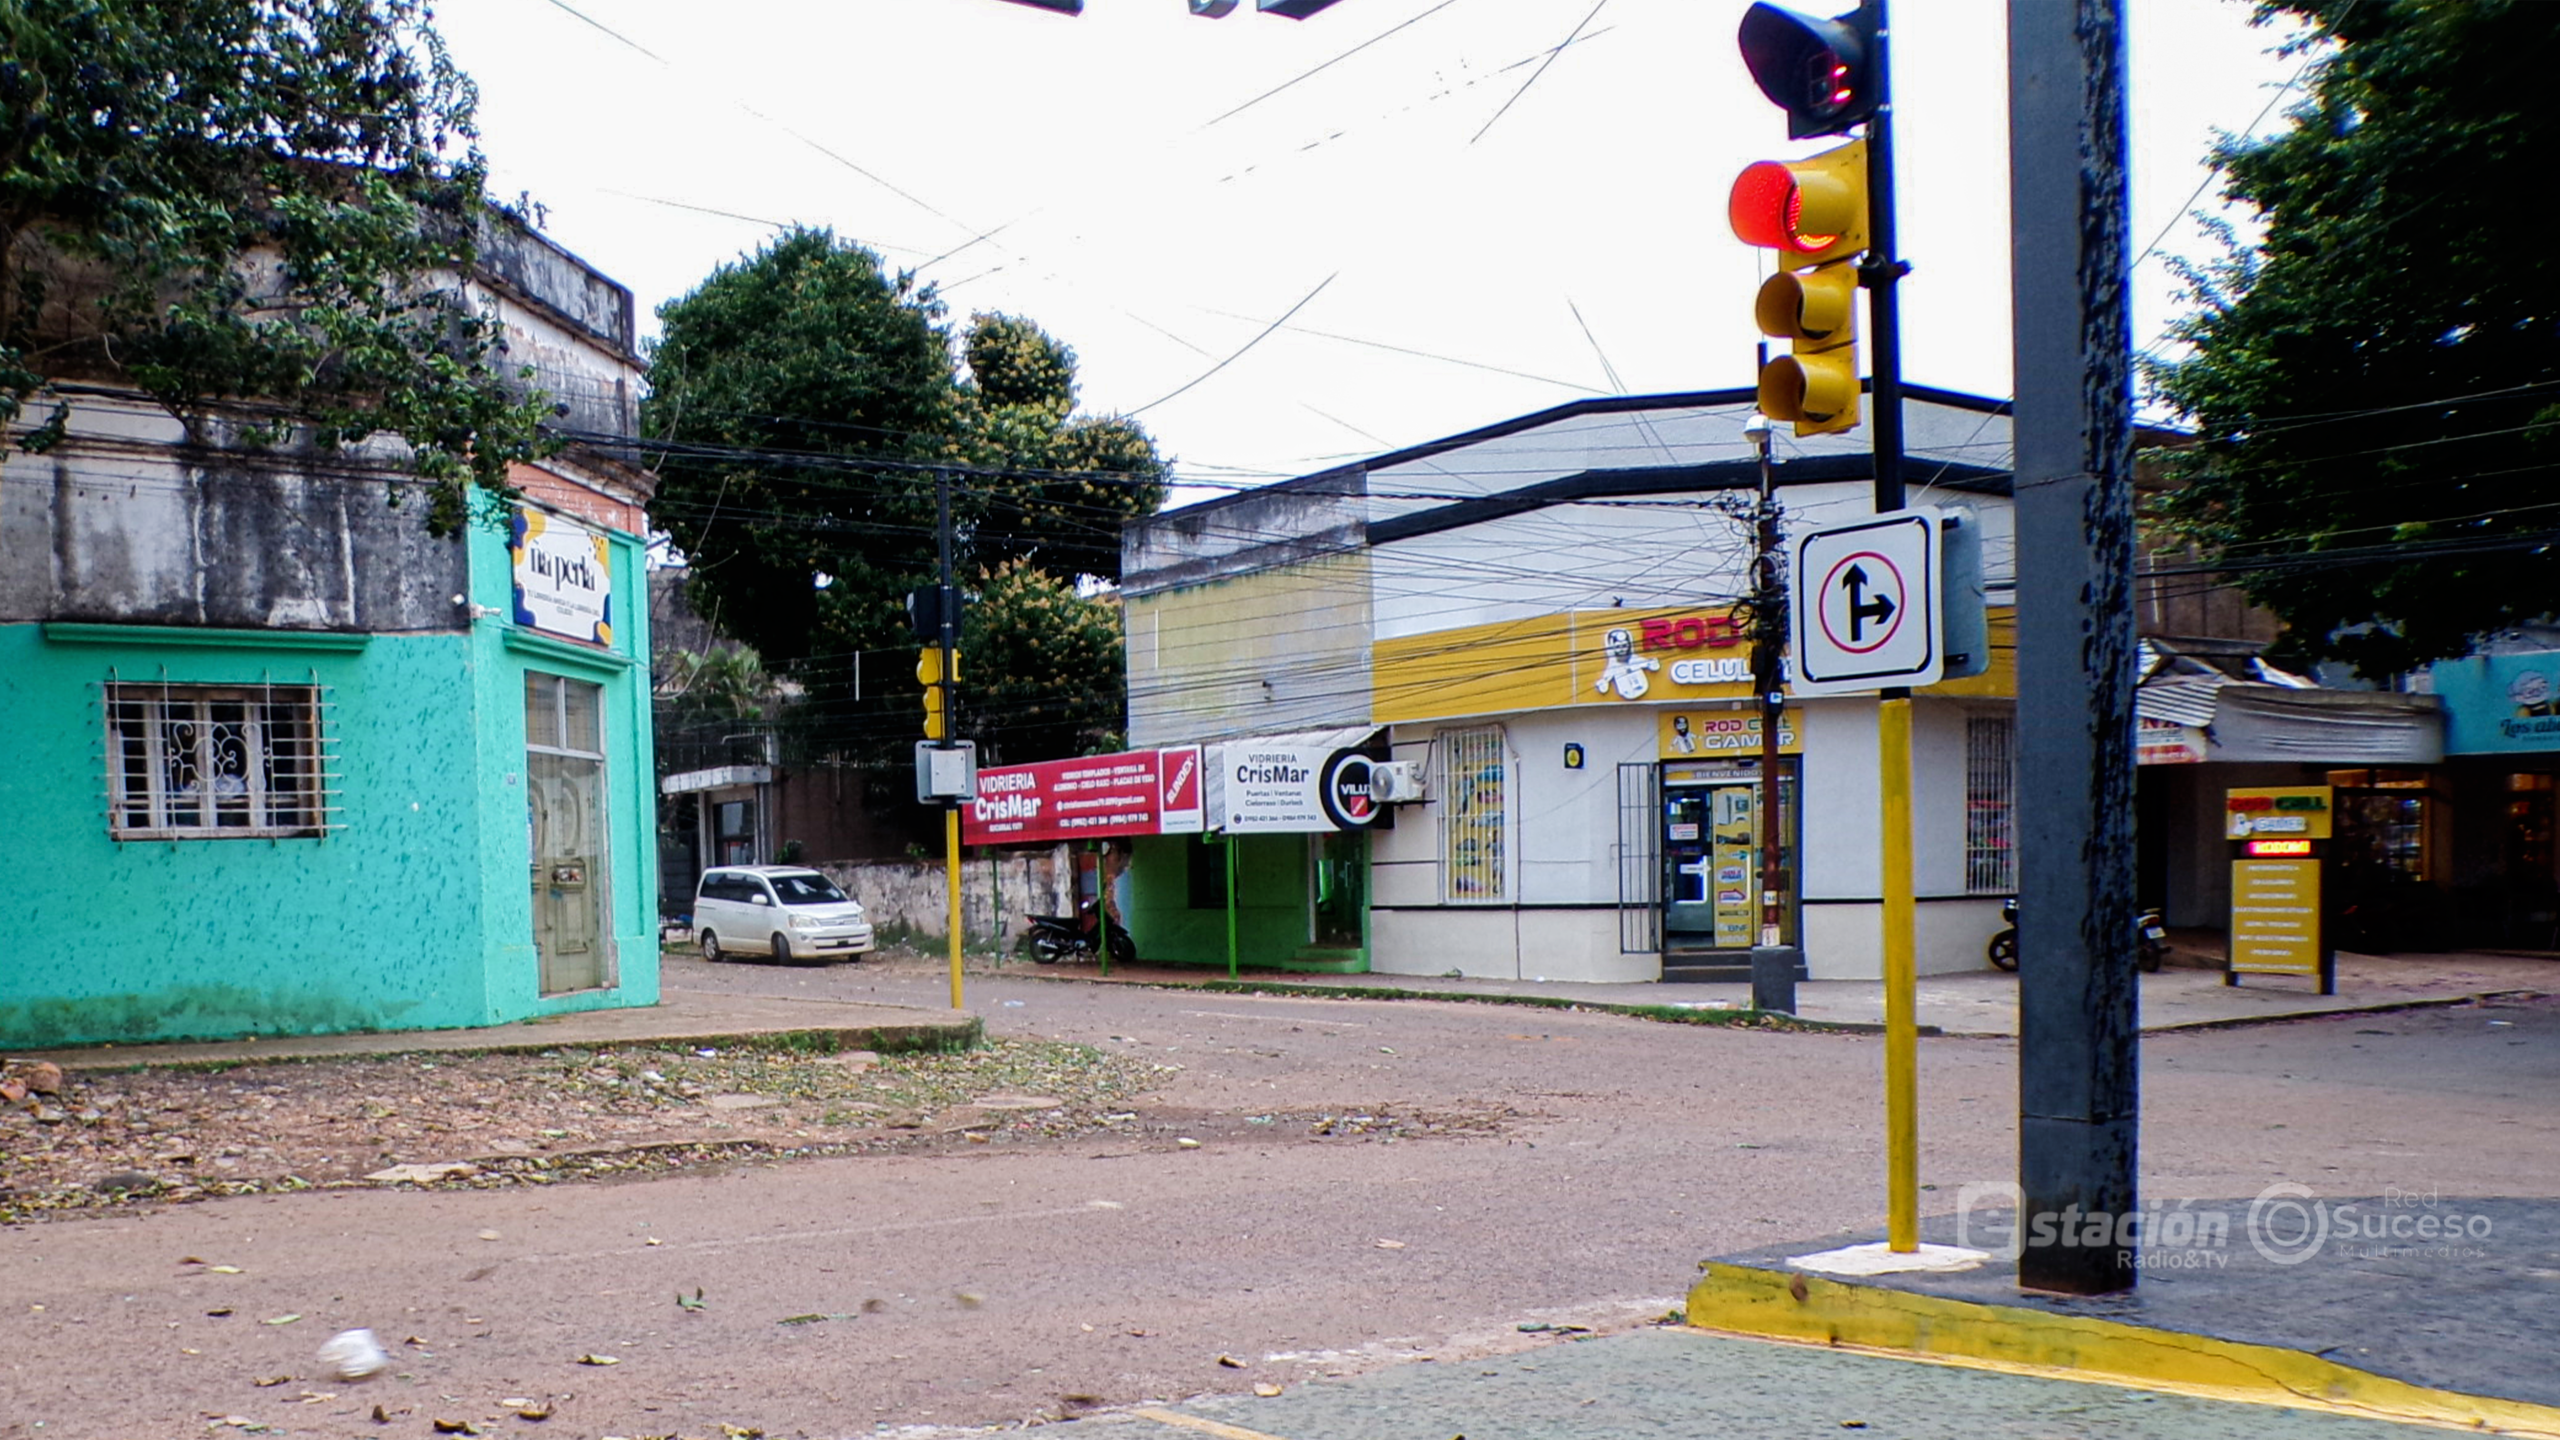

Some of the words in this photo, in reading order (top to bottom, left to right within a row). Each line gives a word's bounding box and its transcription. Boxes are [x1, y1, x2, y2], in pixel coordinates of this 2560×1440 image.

[1640, 616, 1740, 650] ROD
[1705, 720, 1742, 733] ROD
[1705, 732, 1796, 750] GAMR
[1248, 753, 1298, 764] VIDRIERIA
[979, 772, 1036, 793] VIDRIERIA
[1237, 764, 1310, 784] CrisMar
[975, 793, 1042, 821] CrisMar
